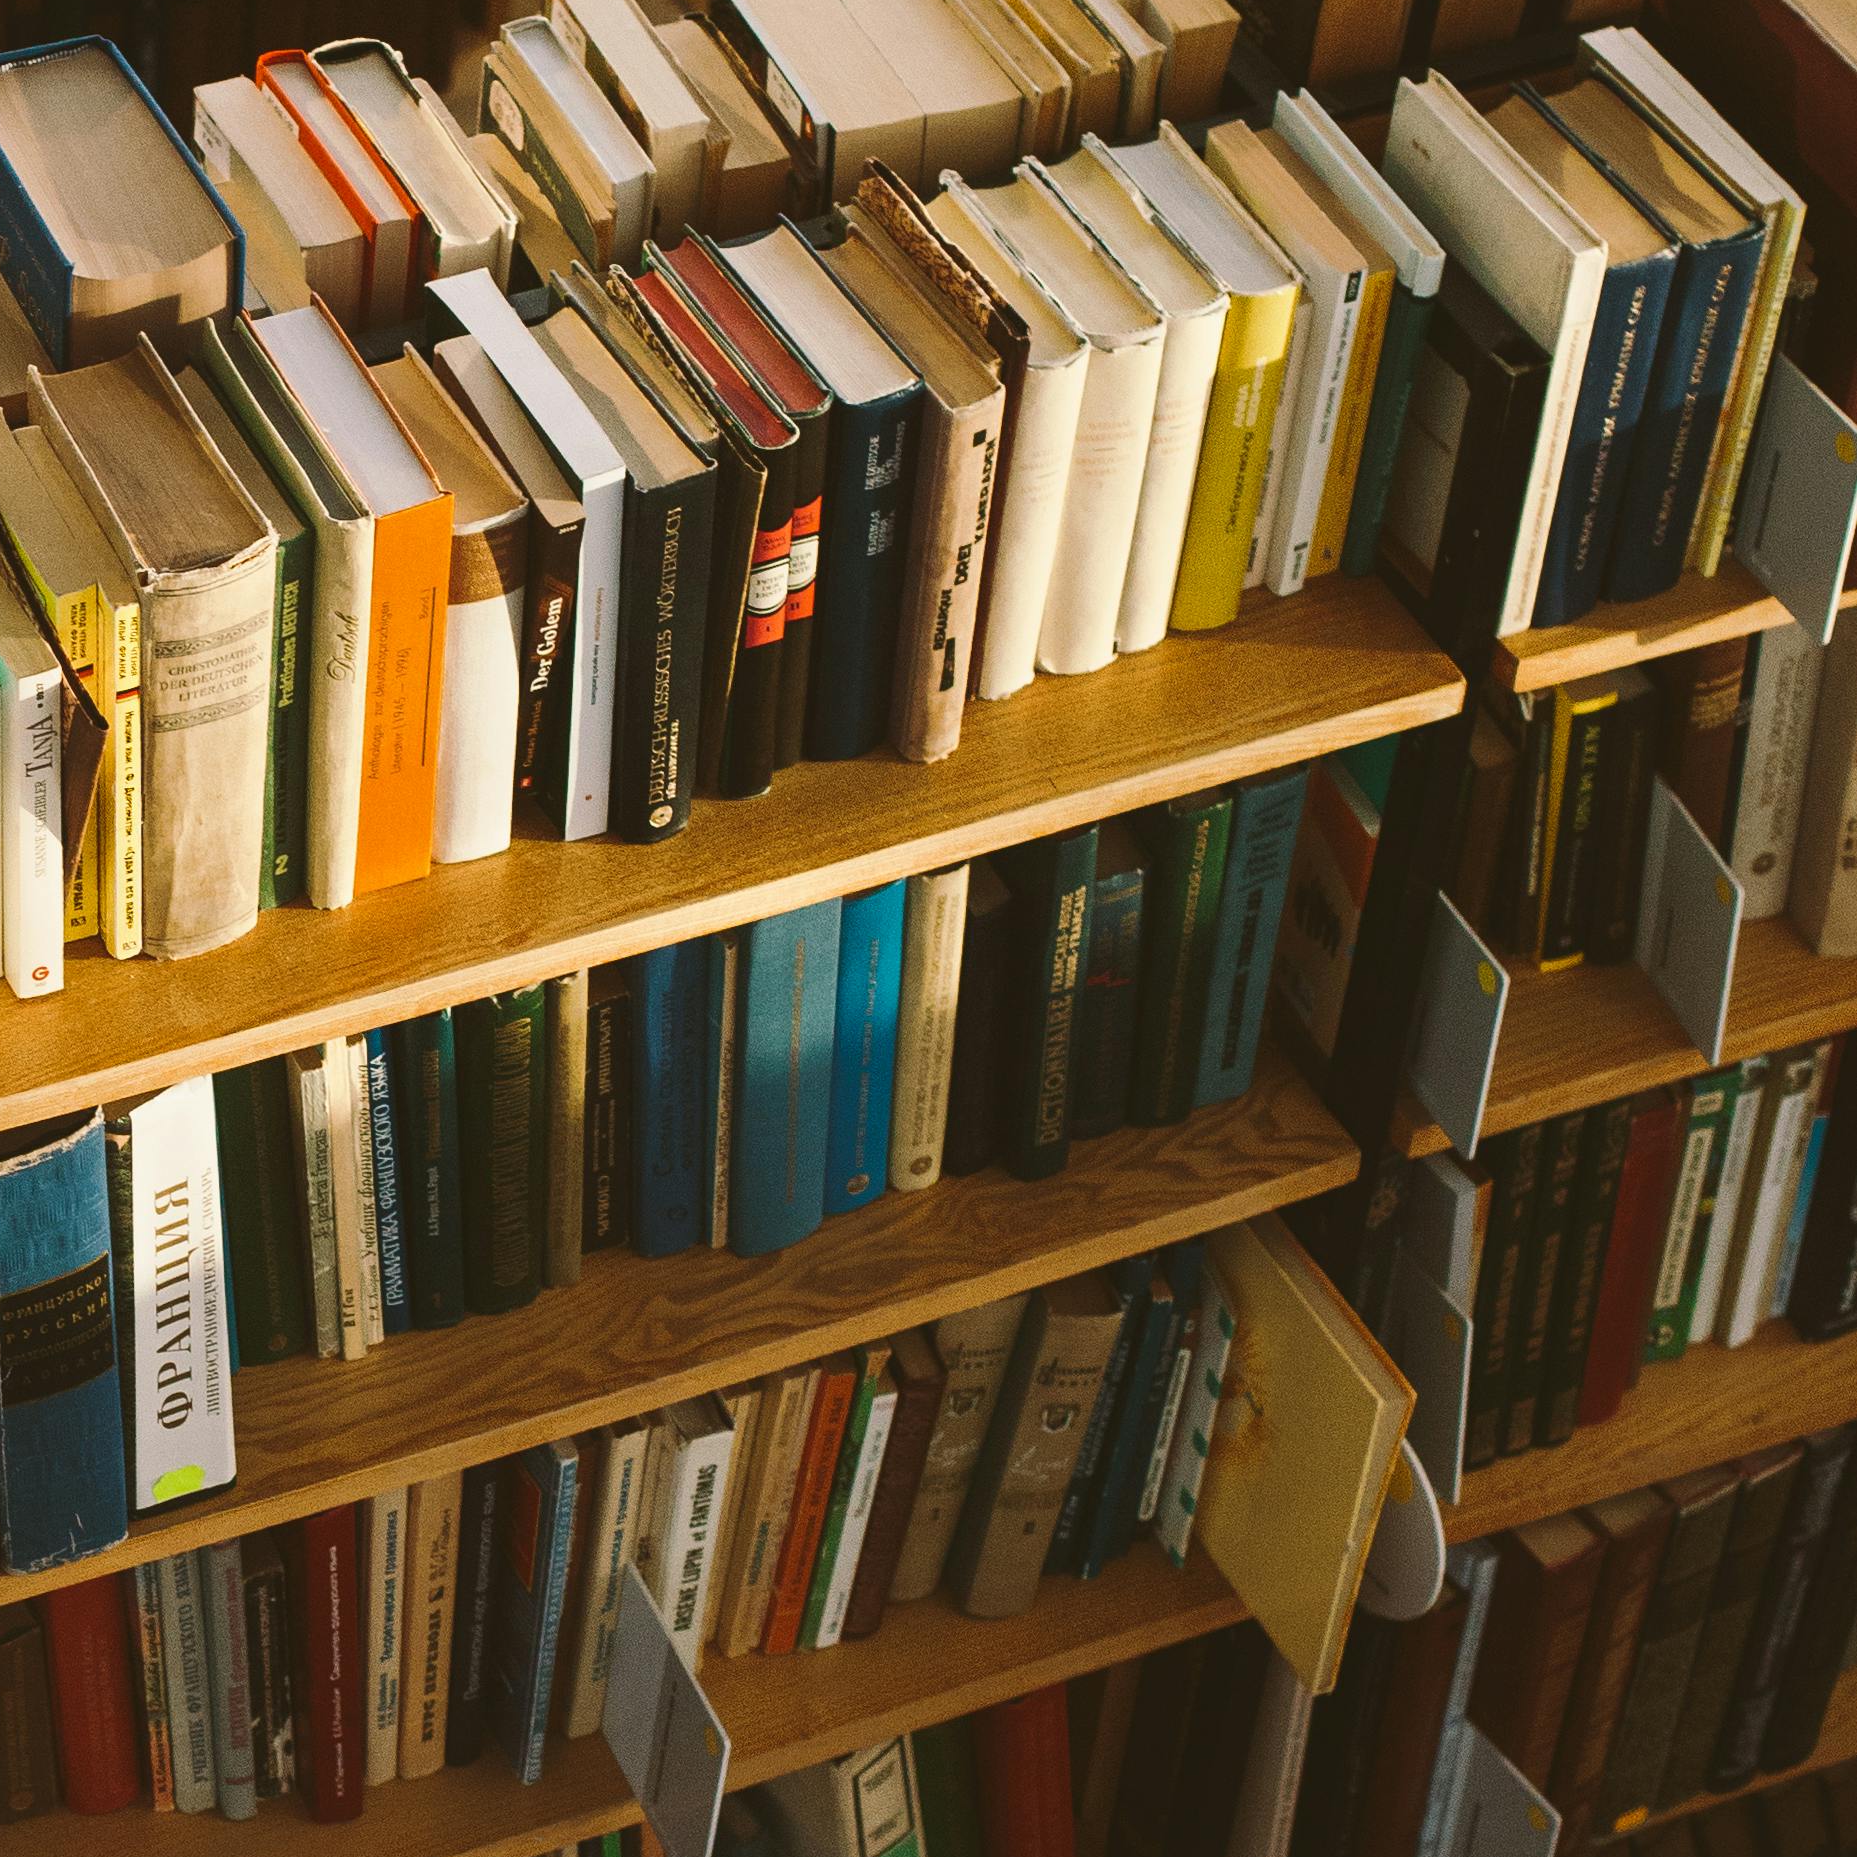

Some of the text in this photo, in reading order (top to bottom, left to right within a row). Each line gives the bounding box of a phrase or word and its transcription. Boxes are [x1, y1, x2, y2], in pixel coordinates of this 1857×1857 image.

[932, 437, 996, 651] REMARQUE DREI KAMERADEN
[278, 579, 300, 707] Praktisches DEUTSCH
[326, 610, 359, 684] Deutsch
[372, 601, 392, 697] deutschsprachigen
[536, 597, 563, 656] Golem
[647, 506, 682, 804] DEUTSCH-RUSSISCHES WÖRTERBUCH
[530, 658, 552, 692] Der
[368, 724, 384, 780] Anthologie
[33, 779, 47, 833] SCHEIBLER
[1037, 994, 1073, 1145] DICTIONNAIRE
[199, 1167, 217, 1231] СЛОВАРЬ
[368, 1052, 405, 1307] ГРАММАТИКА ФРАНЦУЗСКОГО ЯЗЫКА
[152, 1176, 199, 1430] ФРАНЦИЯ
[681, 1548, 704, 1584] LUPIN
